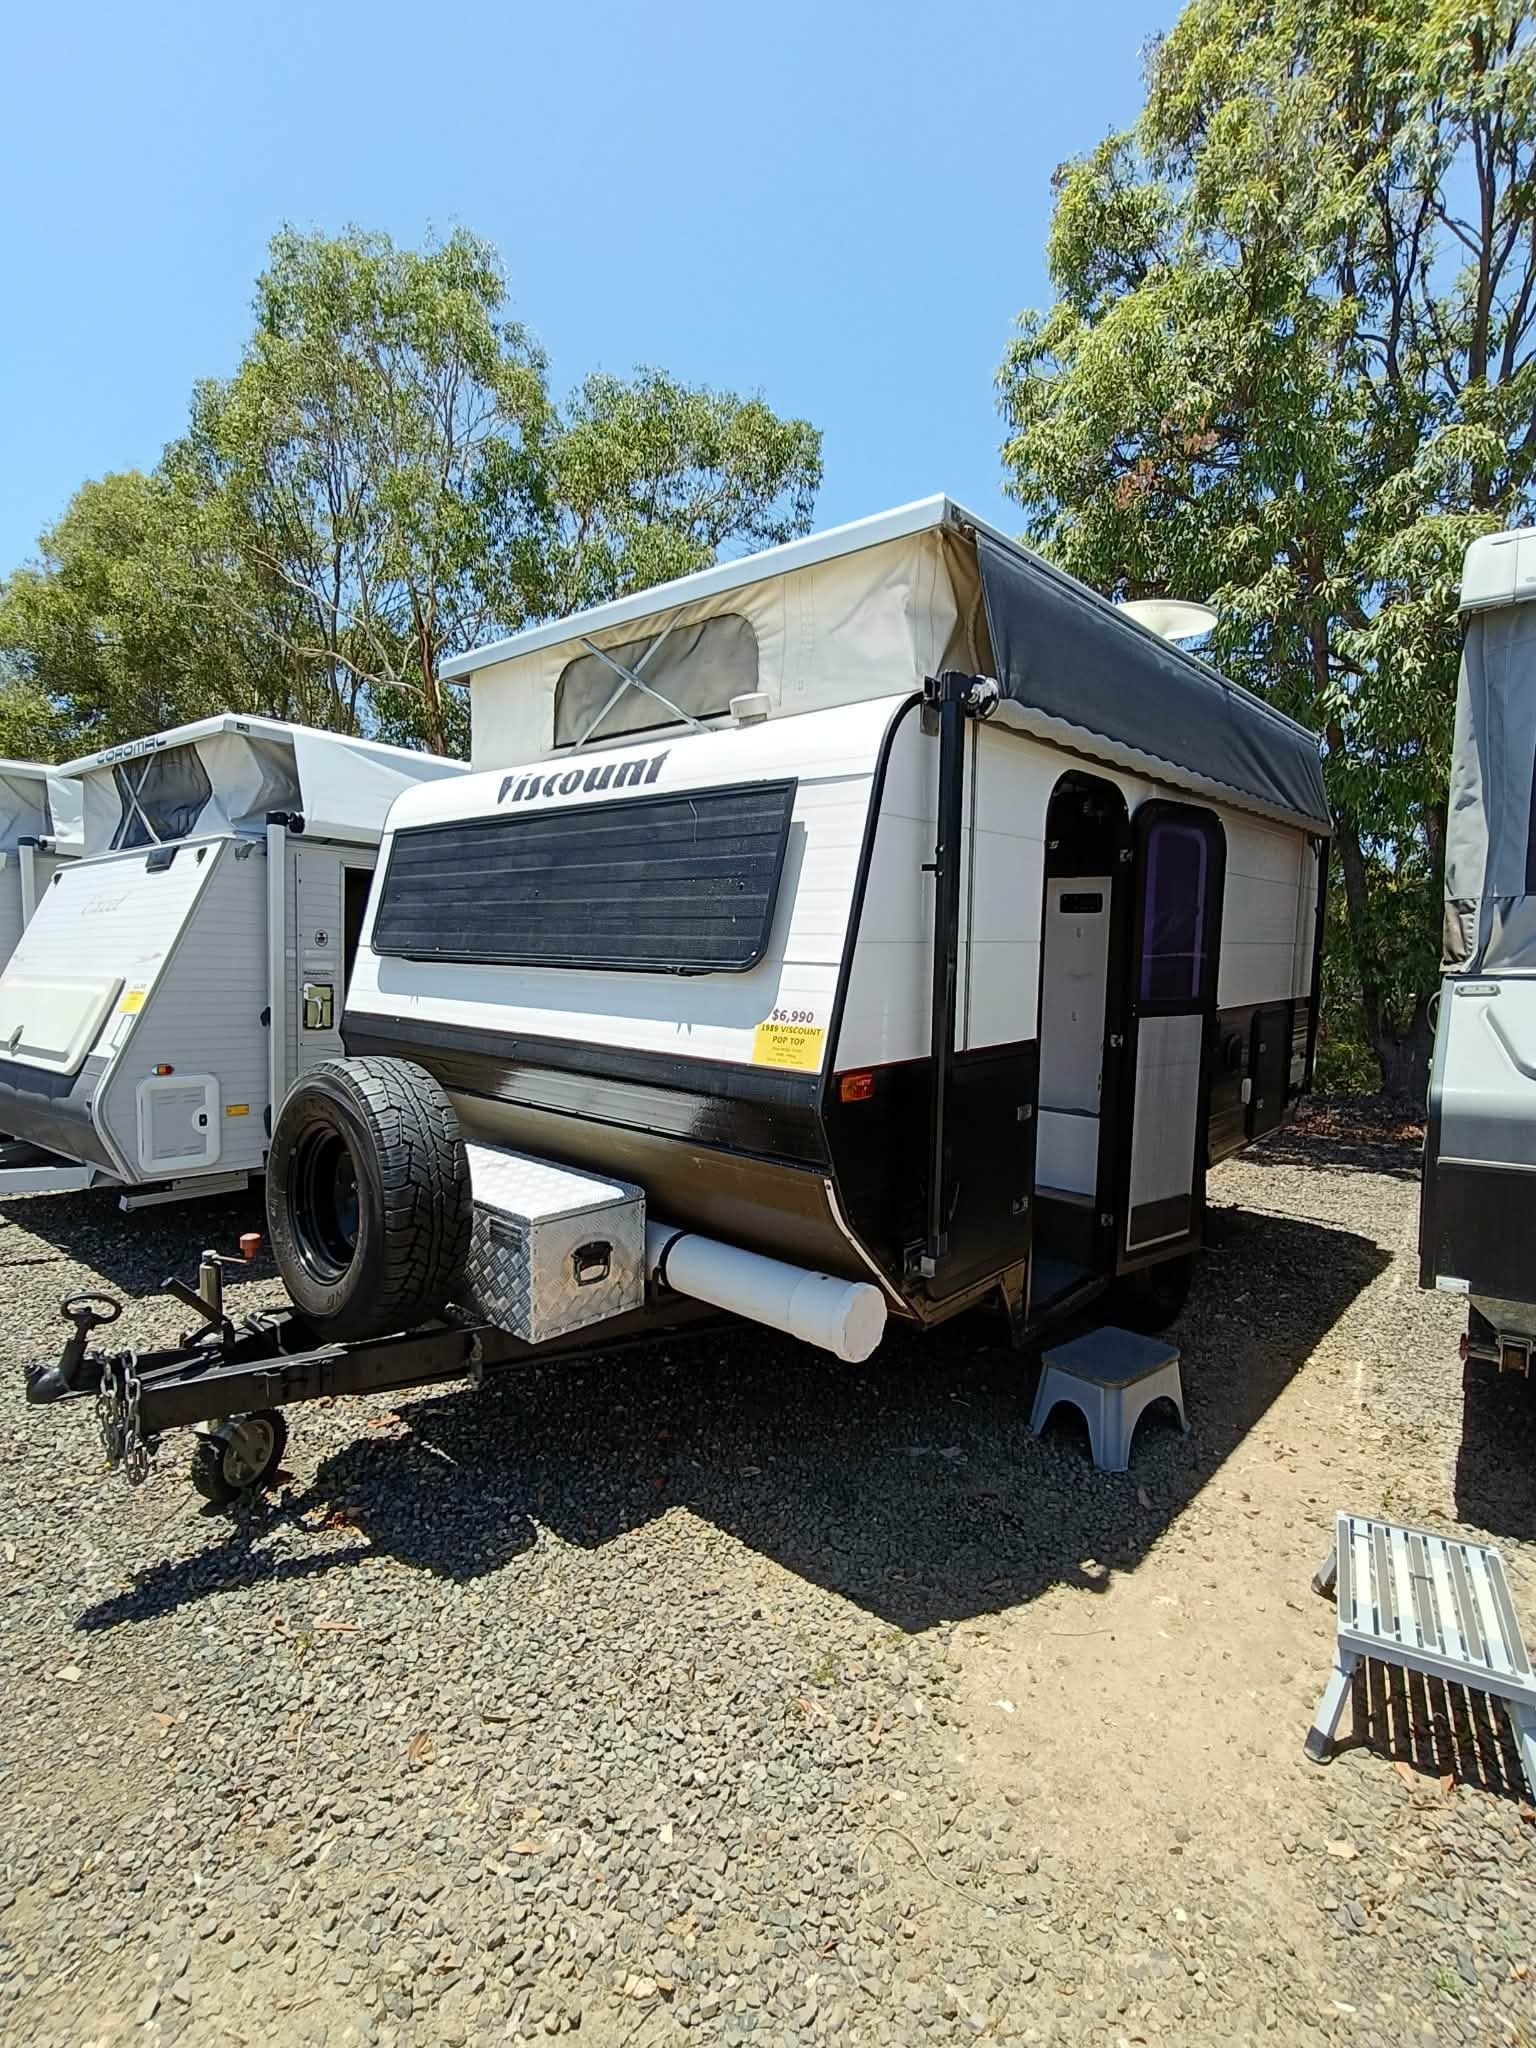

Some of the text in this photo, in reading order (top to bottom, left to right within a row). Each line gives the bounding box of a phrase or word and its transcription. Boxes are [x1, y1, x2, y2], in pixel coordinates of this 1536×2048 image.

[96, 736, 168, 765] COROMAL
[497, 748, 672, 804] Viscount
[771, 1008, 815, 1024] $6,990
[760, 1023, 823, 1037] 1989 VISCOUNT
[772, 1036, 806, 1047] POP TOP
